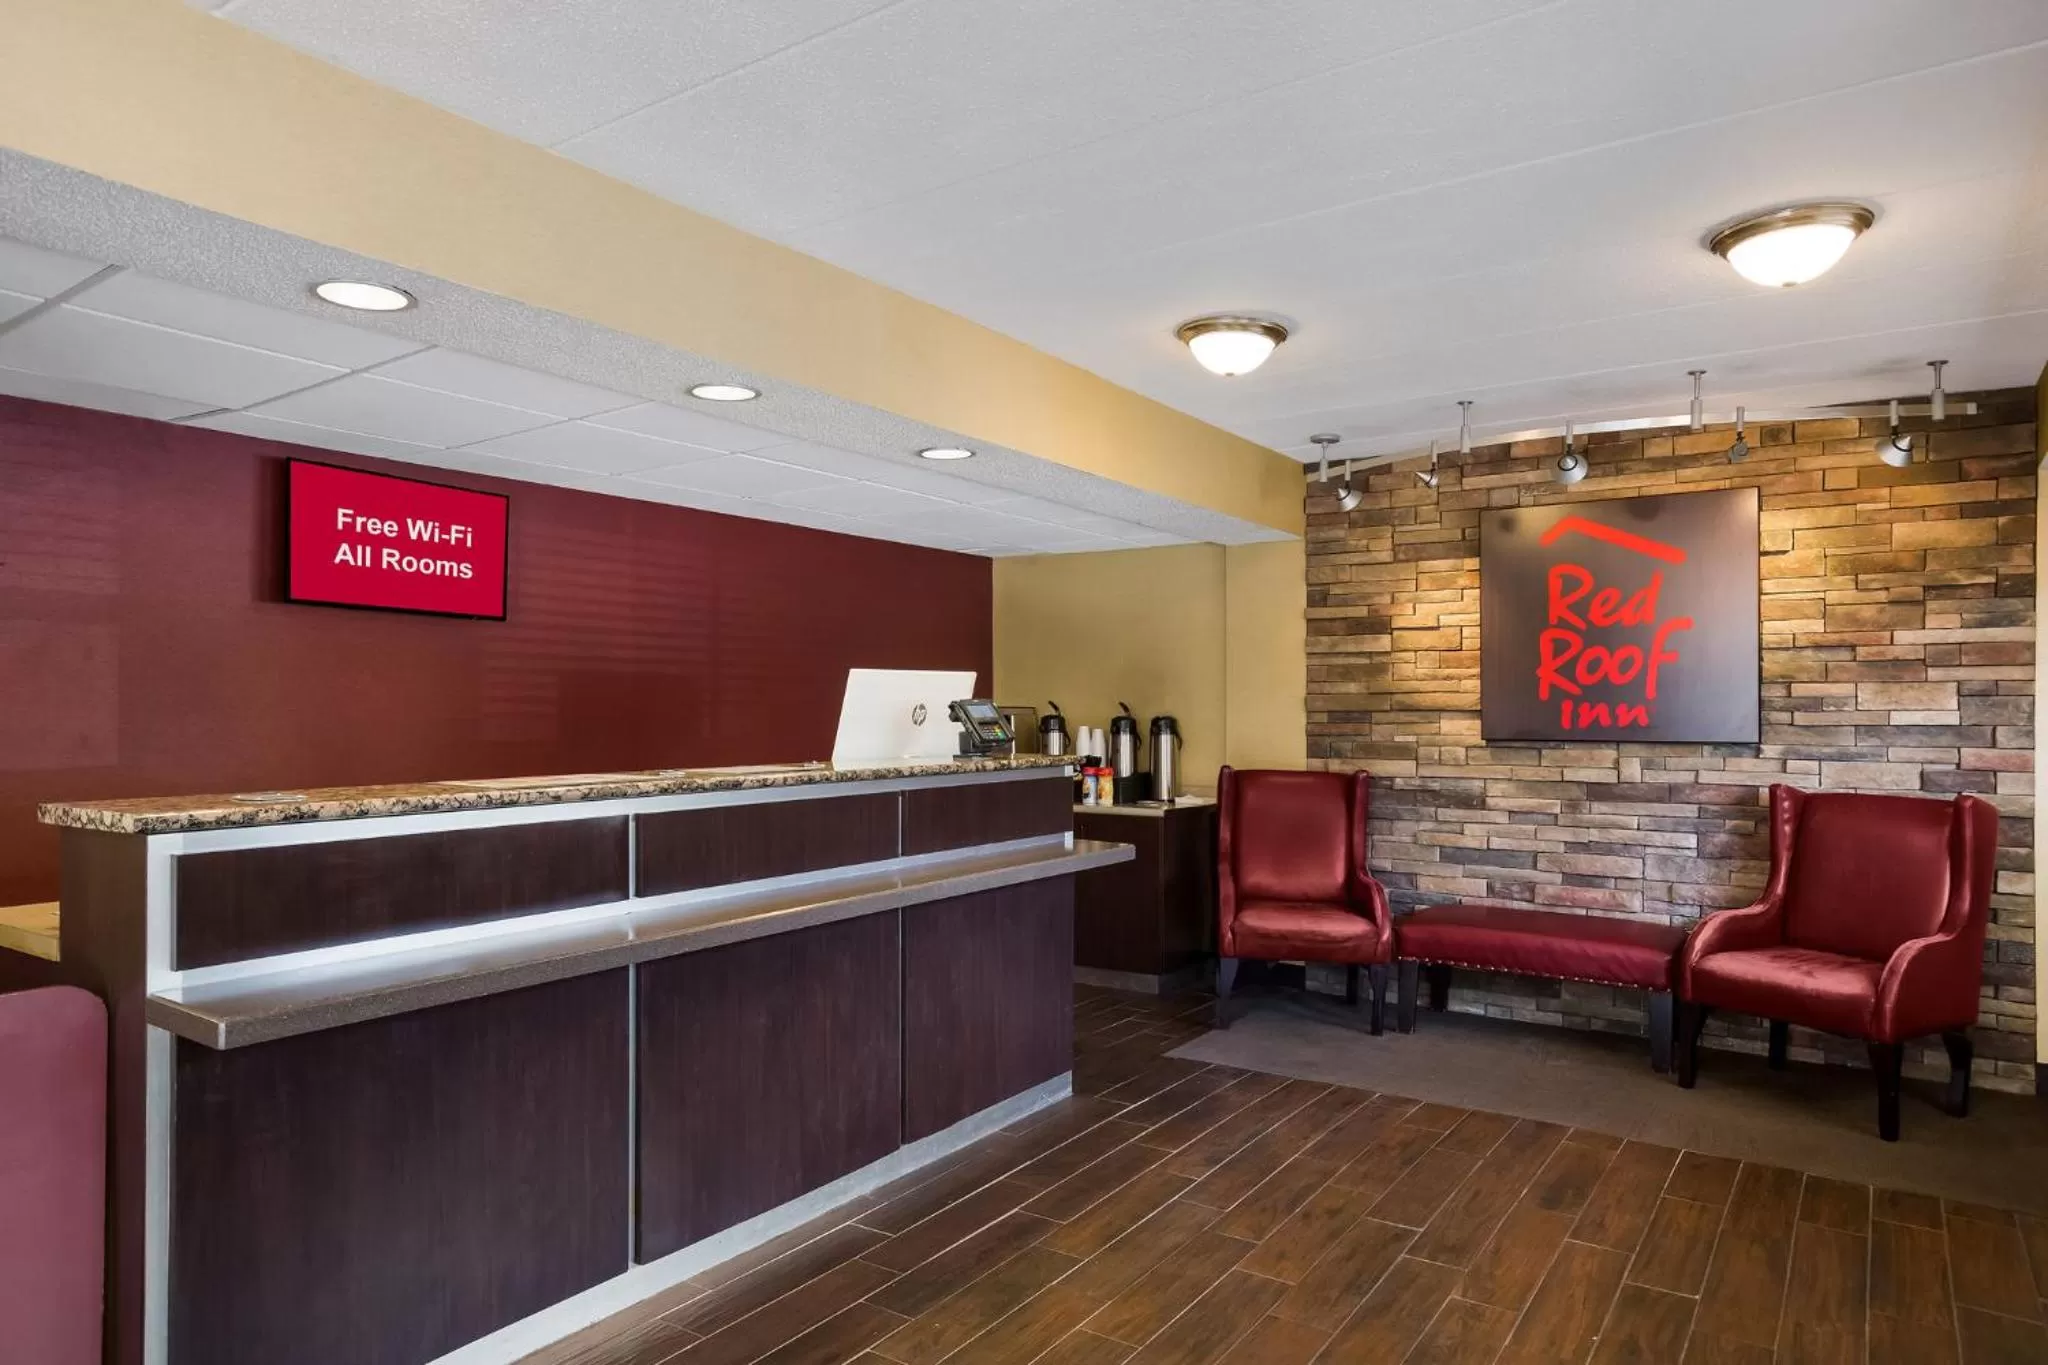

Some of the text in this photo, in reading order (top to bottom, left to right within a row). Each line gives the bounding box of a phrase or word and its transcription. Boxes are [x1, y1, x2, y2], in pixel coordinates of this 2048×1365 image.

[337, 507, 473, 548] Free Wi-Fi
[334, 543, 473, 579] All Rooms
[1548, 564, 1664, 631] Red
[1536, 616, 1695, 700] Roof
